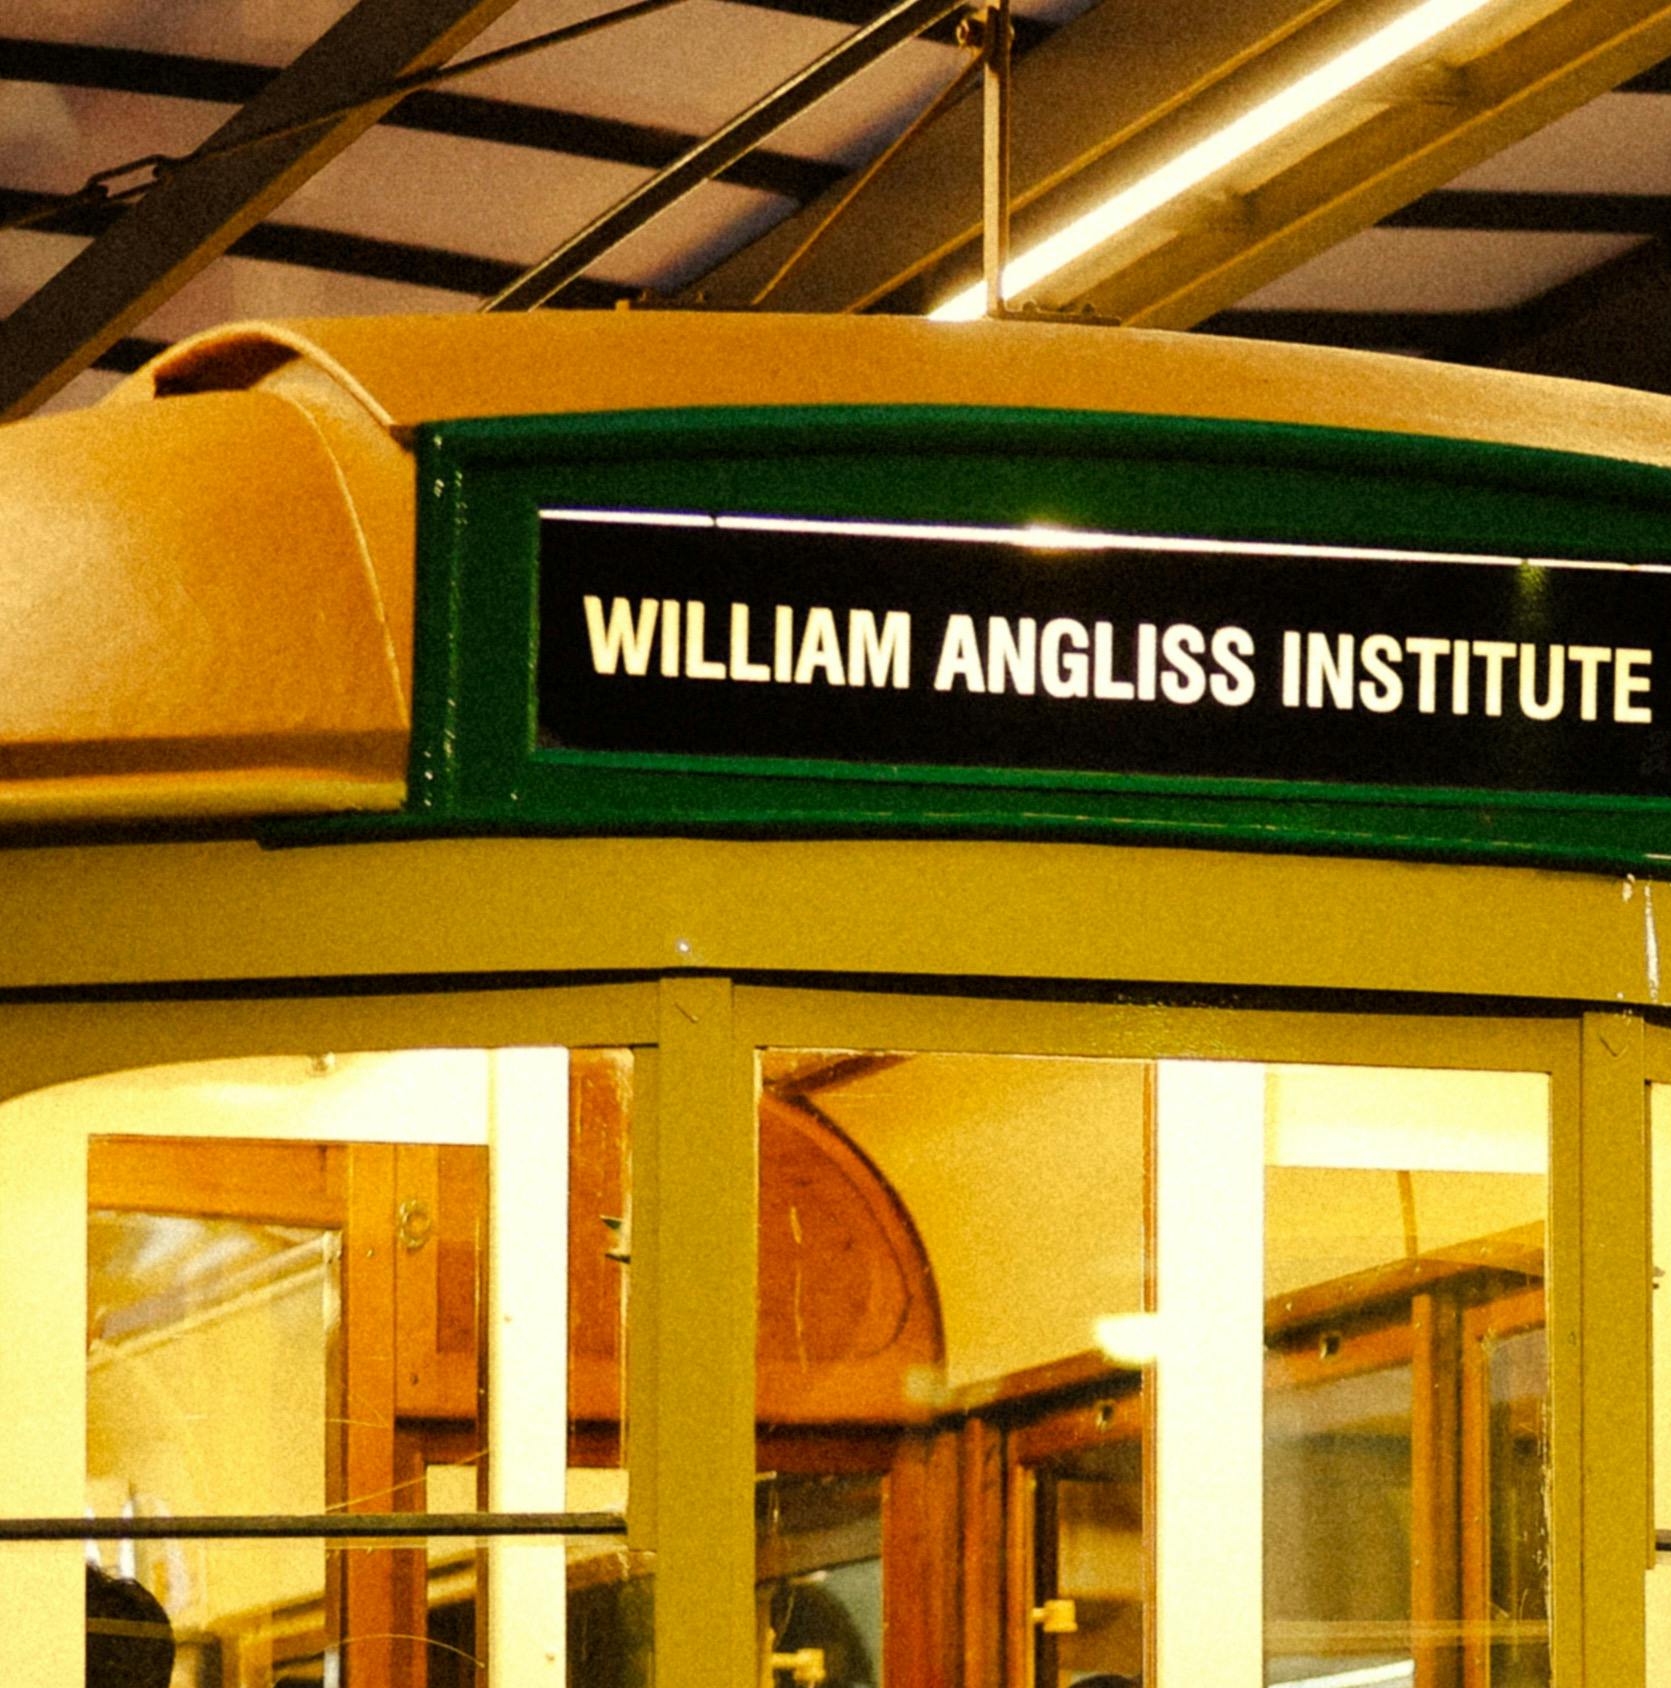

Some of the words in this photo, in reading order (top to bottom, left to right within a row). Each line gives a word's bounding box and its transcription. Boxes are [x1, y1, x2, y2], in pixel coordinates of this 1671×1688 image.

[582, 595, 912, 690] WILLIAM
[932, 613, 1257, 708] ANGLISS
[1280, 630, 1653, 725] INSTITUTE
